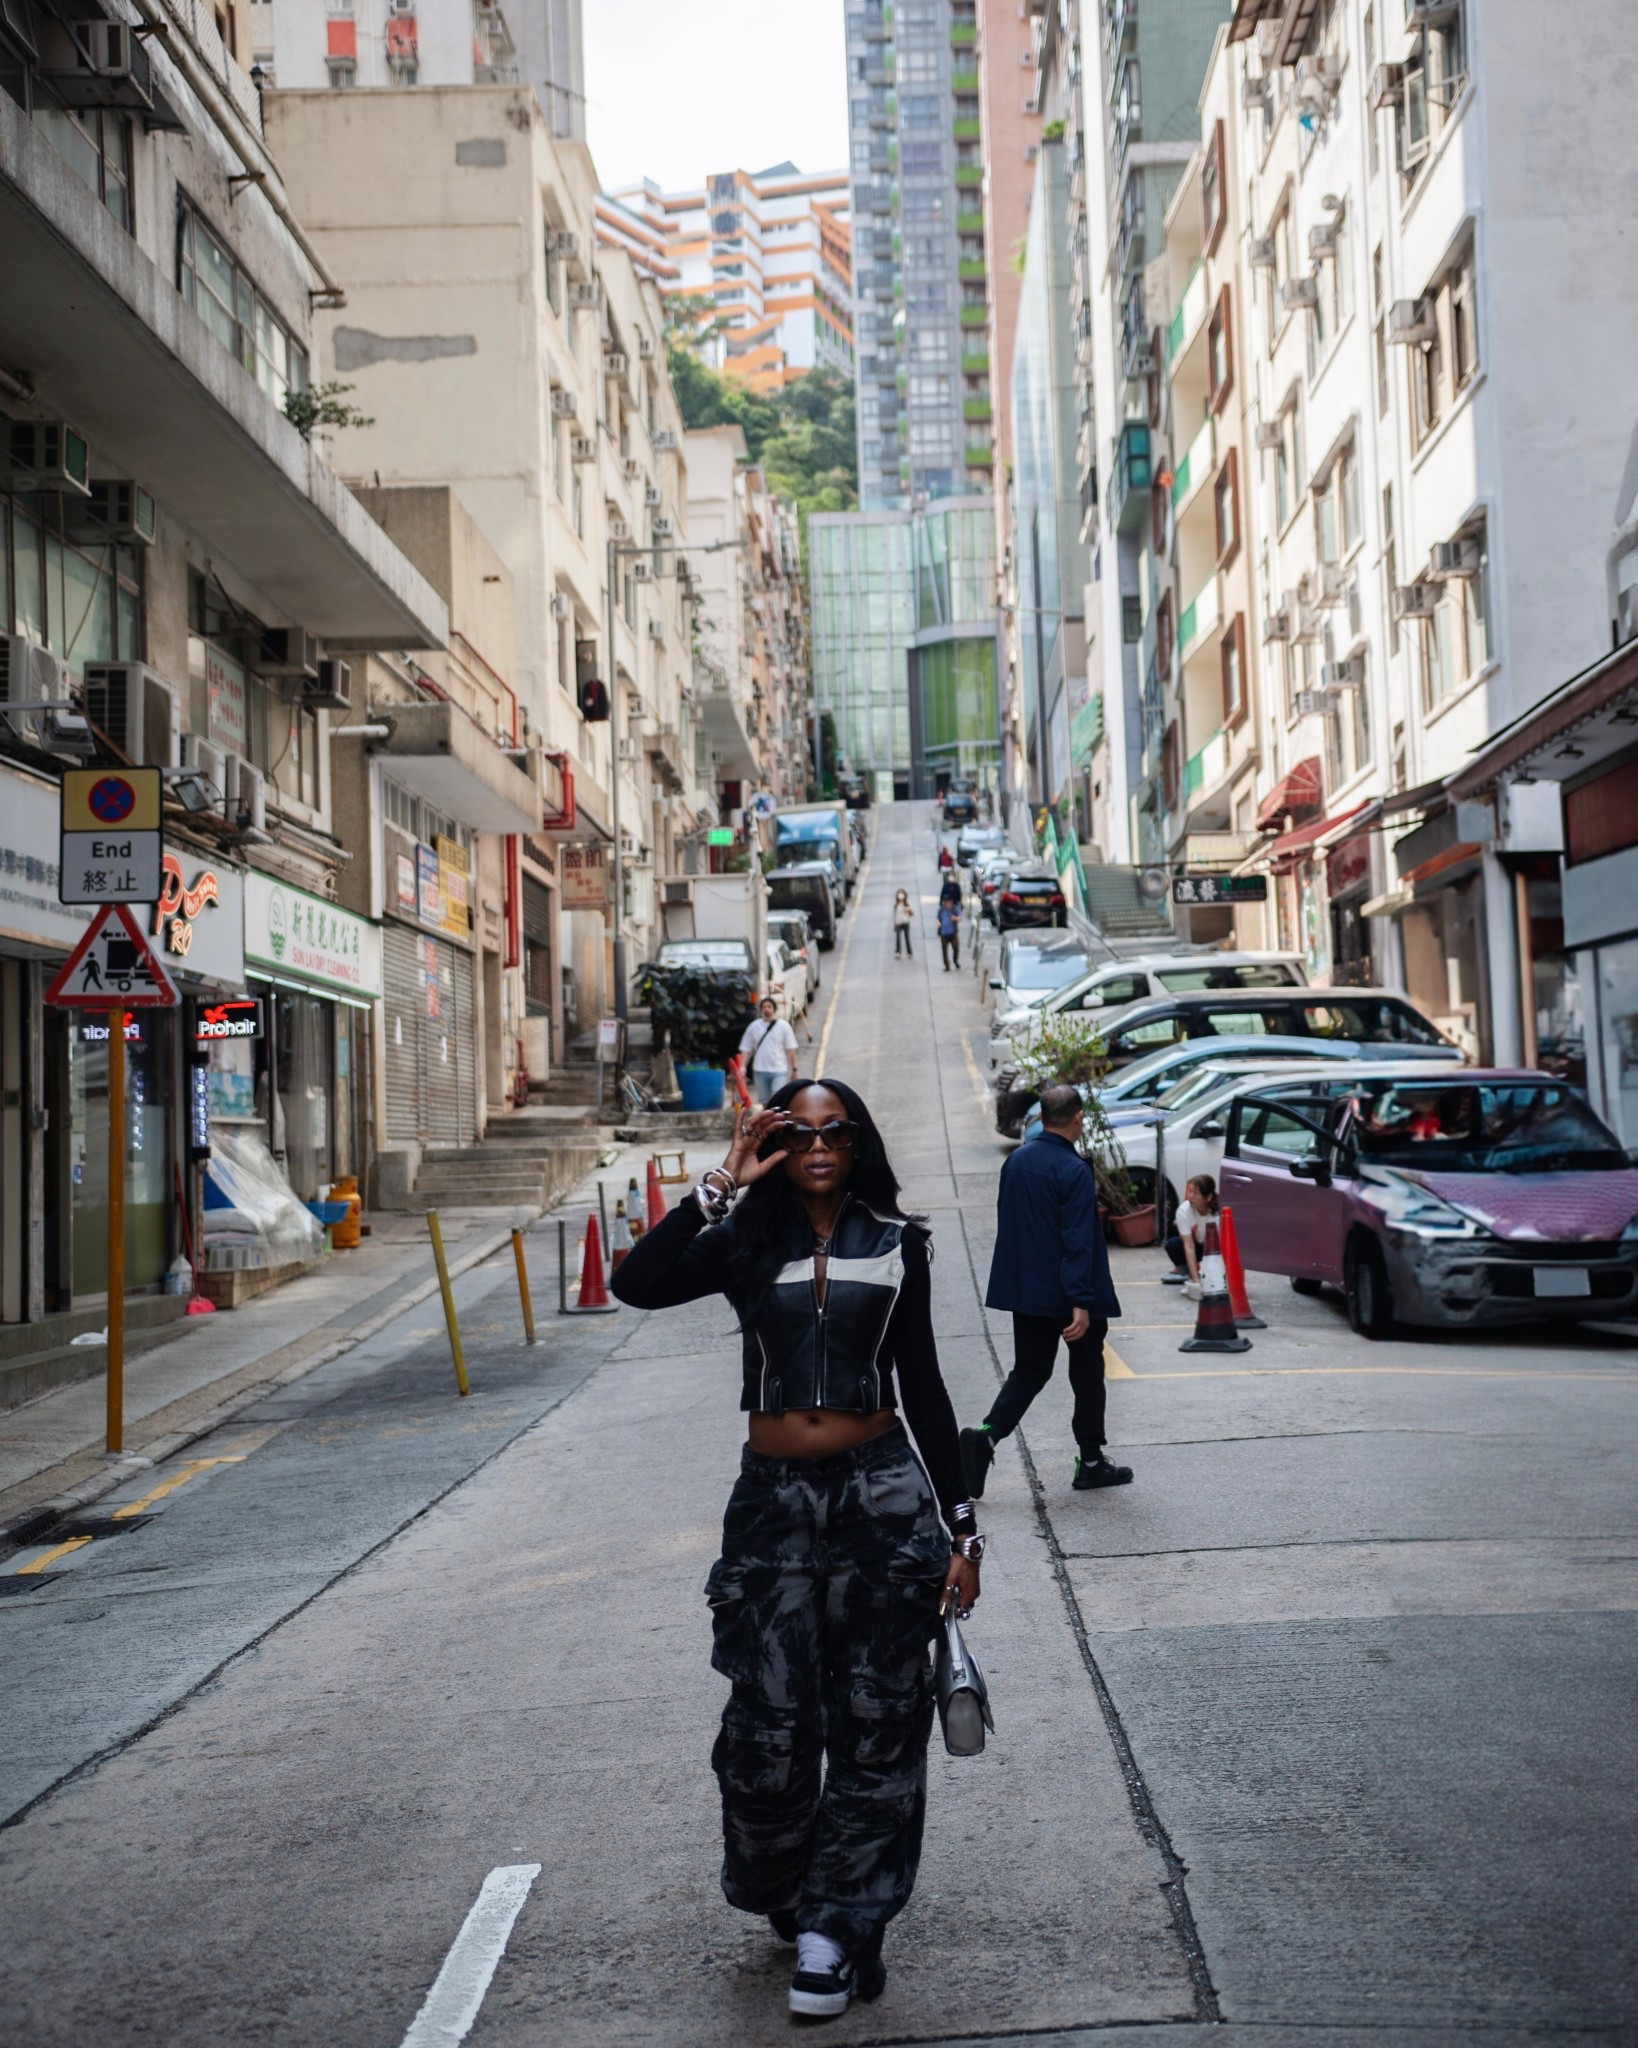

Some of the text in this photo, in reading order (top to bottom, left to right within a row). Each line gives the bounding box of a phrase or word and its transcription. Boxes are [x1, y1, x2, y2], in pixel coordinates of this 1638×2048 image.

[92, 841, 132, 858] End
[83, 869, 139, 893] 終止
[273, 901, 283, 928] SL
[292, 946, 304, 965] SUN
[316, 954, 326, 972] DRY
[327, 958, 352, 980] CLEANING
[199, 1019, 257, 1038] Prohair
